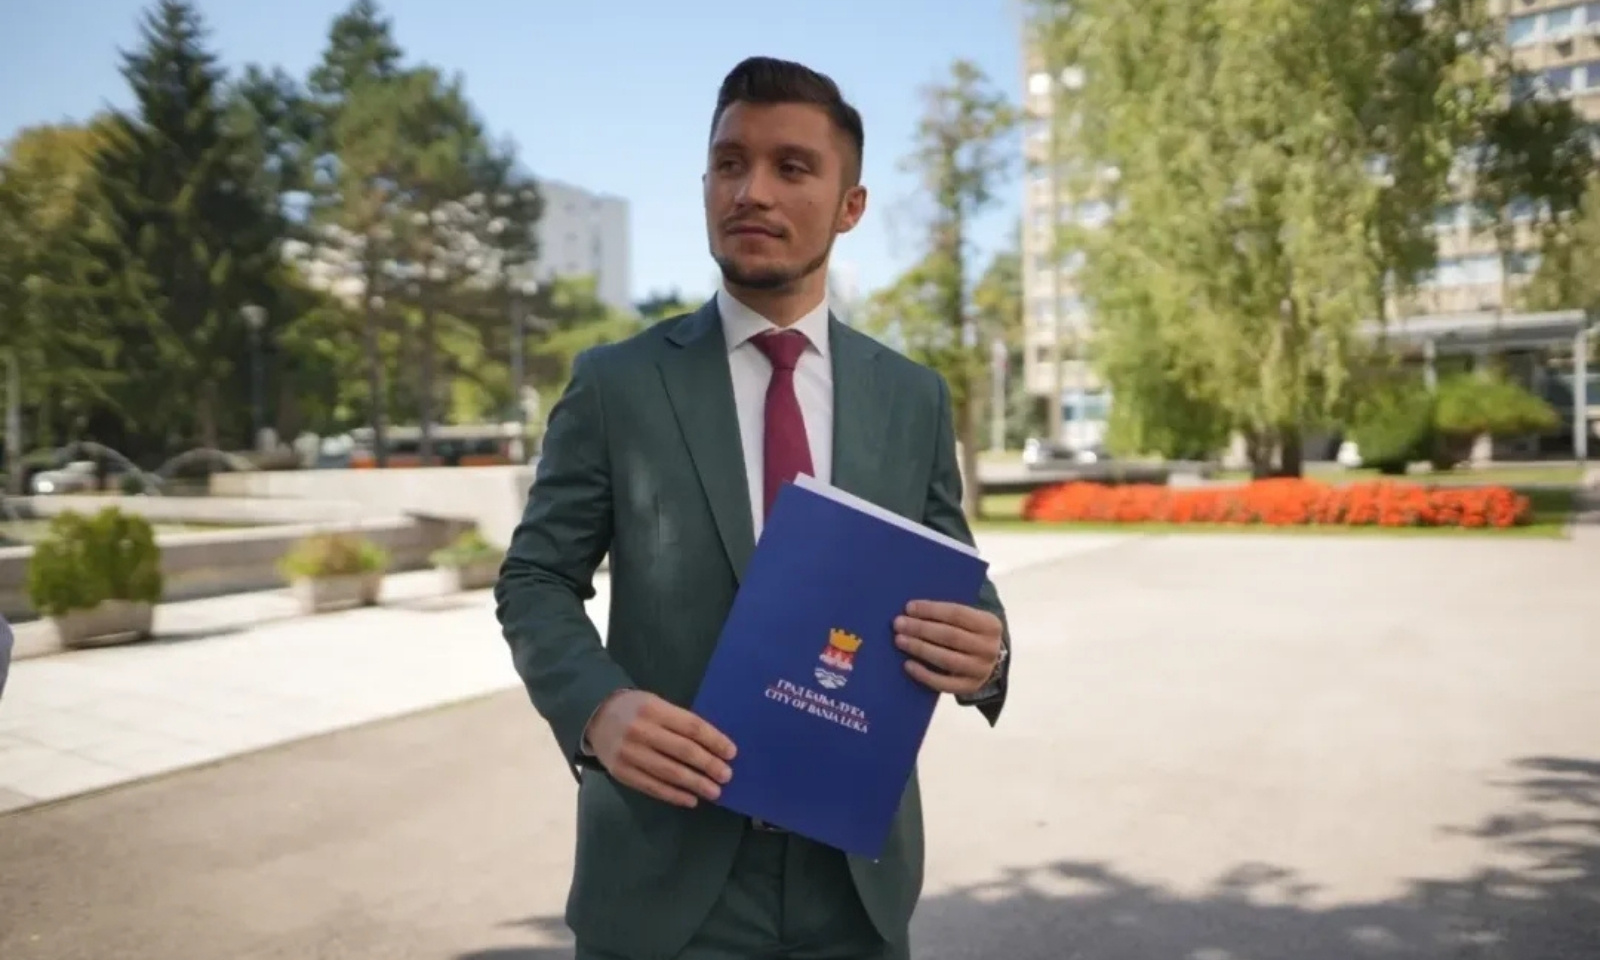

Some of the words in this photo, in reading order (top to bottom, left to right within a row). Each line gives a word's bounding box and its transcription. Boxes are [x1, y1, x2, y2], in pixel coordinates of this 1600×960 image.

[777, 679, 804, 697] ГРАД
[765, 688, 790, 704] CITY
[792, 698, 807, 710] OF
[808, 704, 838, 722] BANJA
[840, 716, 867, 733] LUKA
